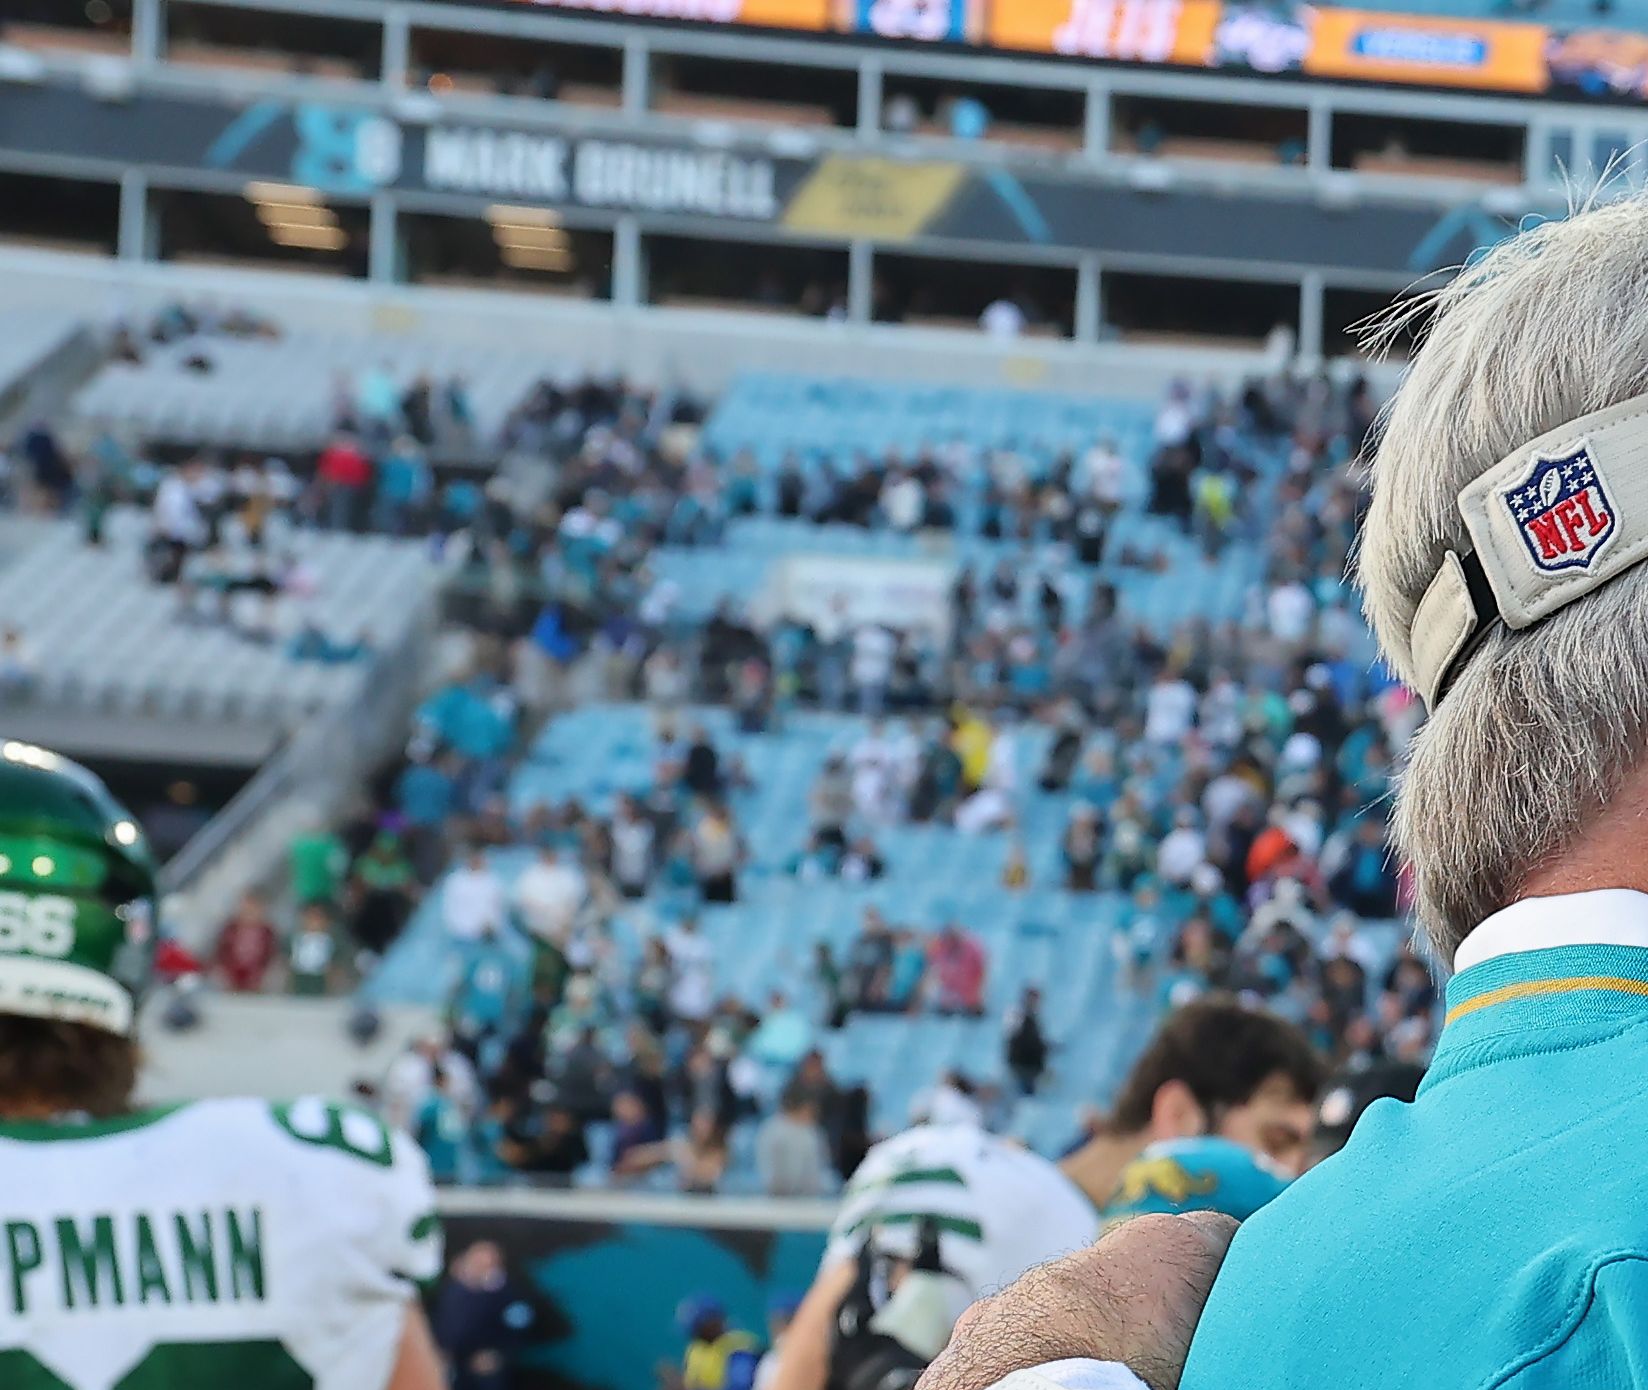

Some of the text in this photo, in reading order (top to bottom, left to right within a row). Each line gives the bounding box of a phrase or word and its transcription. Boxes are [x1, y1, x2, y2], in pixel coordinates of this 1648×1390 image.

[424, 127, 567, 192] MARK
[575, 131, 779, 218] BRUNELL
[1528, 490, 1609, 560] NFL
[5, 1208, 266, 1315] PMANN
